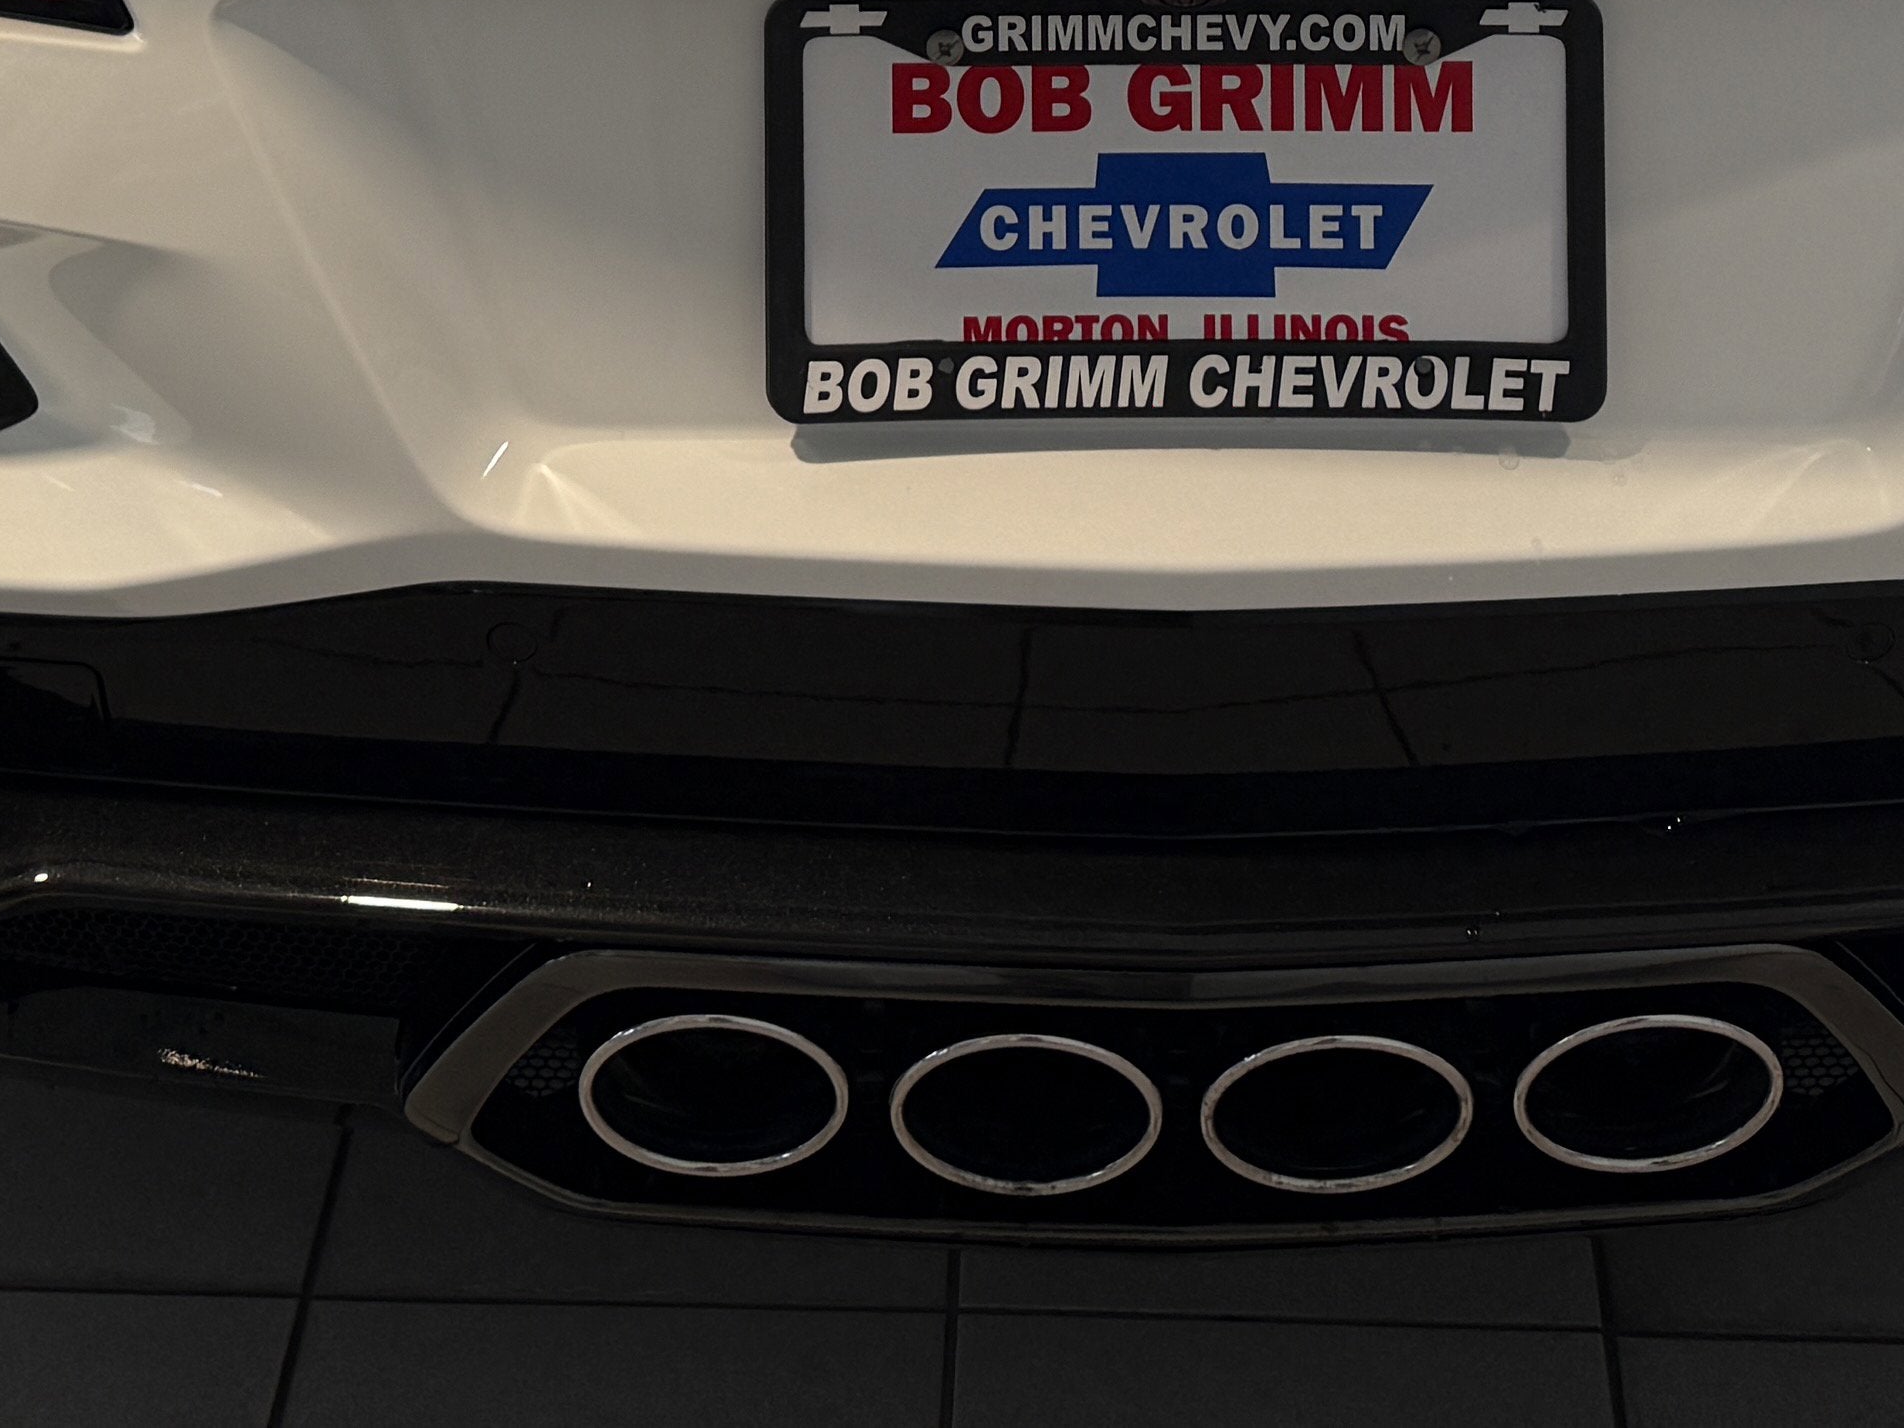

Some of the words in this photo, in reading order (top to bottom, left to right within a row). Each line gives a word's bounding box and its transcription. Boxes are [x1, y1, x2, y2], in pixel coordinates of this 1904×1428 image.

[962, 12, 1407, 54] GRIMMCHEVY.COM
[891, 62, 1094, 135] BOB
[1126, 61, 1474, 134] GRIMM
[979, 202, 1385, 252] CHEVROLET
[803, 359, 933, 414] BOB
[955, 355, 1168, 411] GRIMM
[1190, 355, 1570, 413] CHEVROLET
